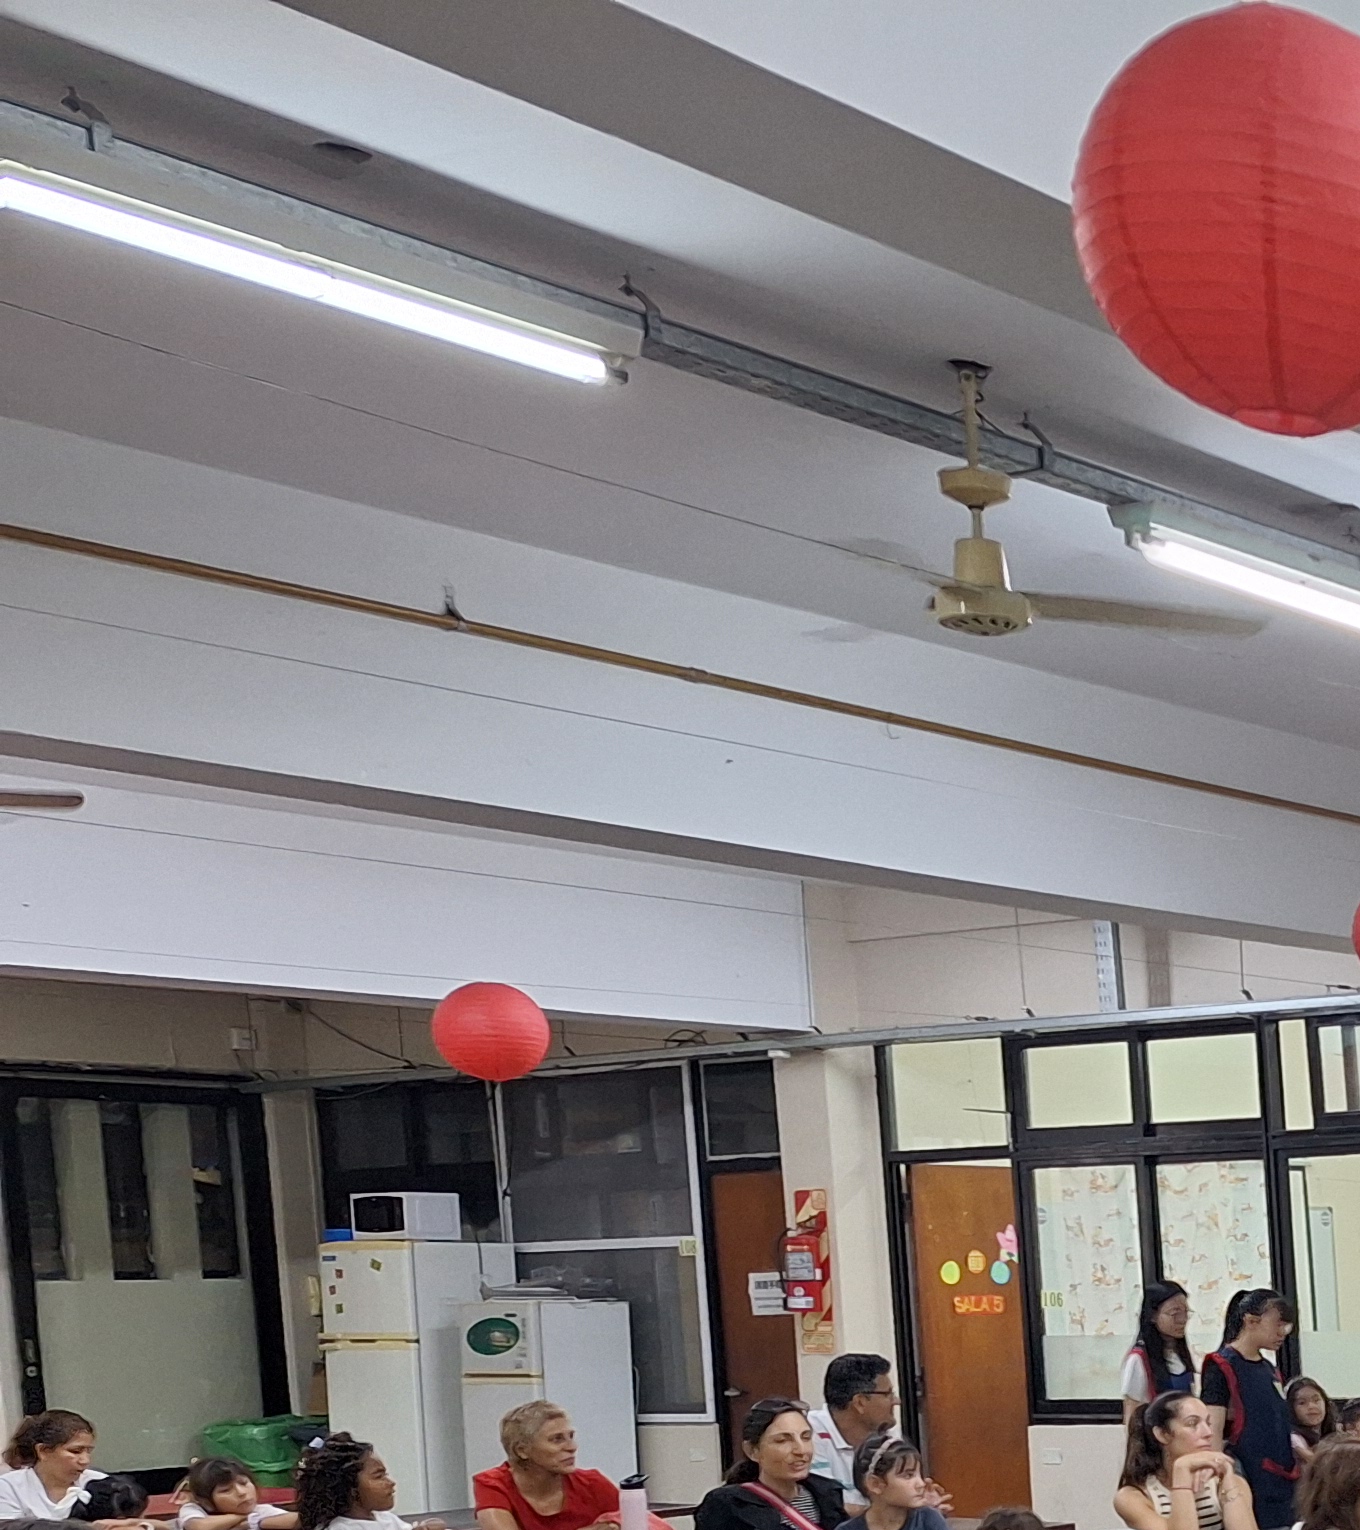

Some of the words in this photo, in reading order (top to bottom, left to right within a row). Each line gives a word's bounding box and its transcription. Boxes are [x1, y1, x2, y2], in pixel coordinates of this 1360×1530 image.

[953, 1296, 990, 1313] SALA
[993, 1296, 1004, 1312] 5
[1043, 1292, 1064, 1307] 106
